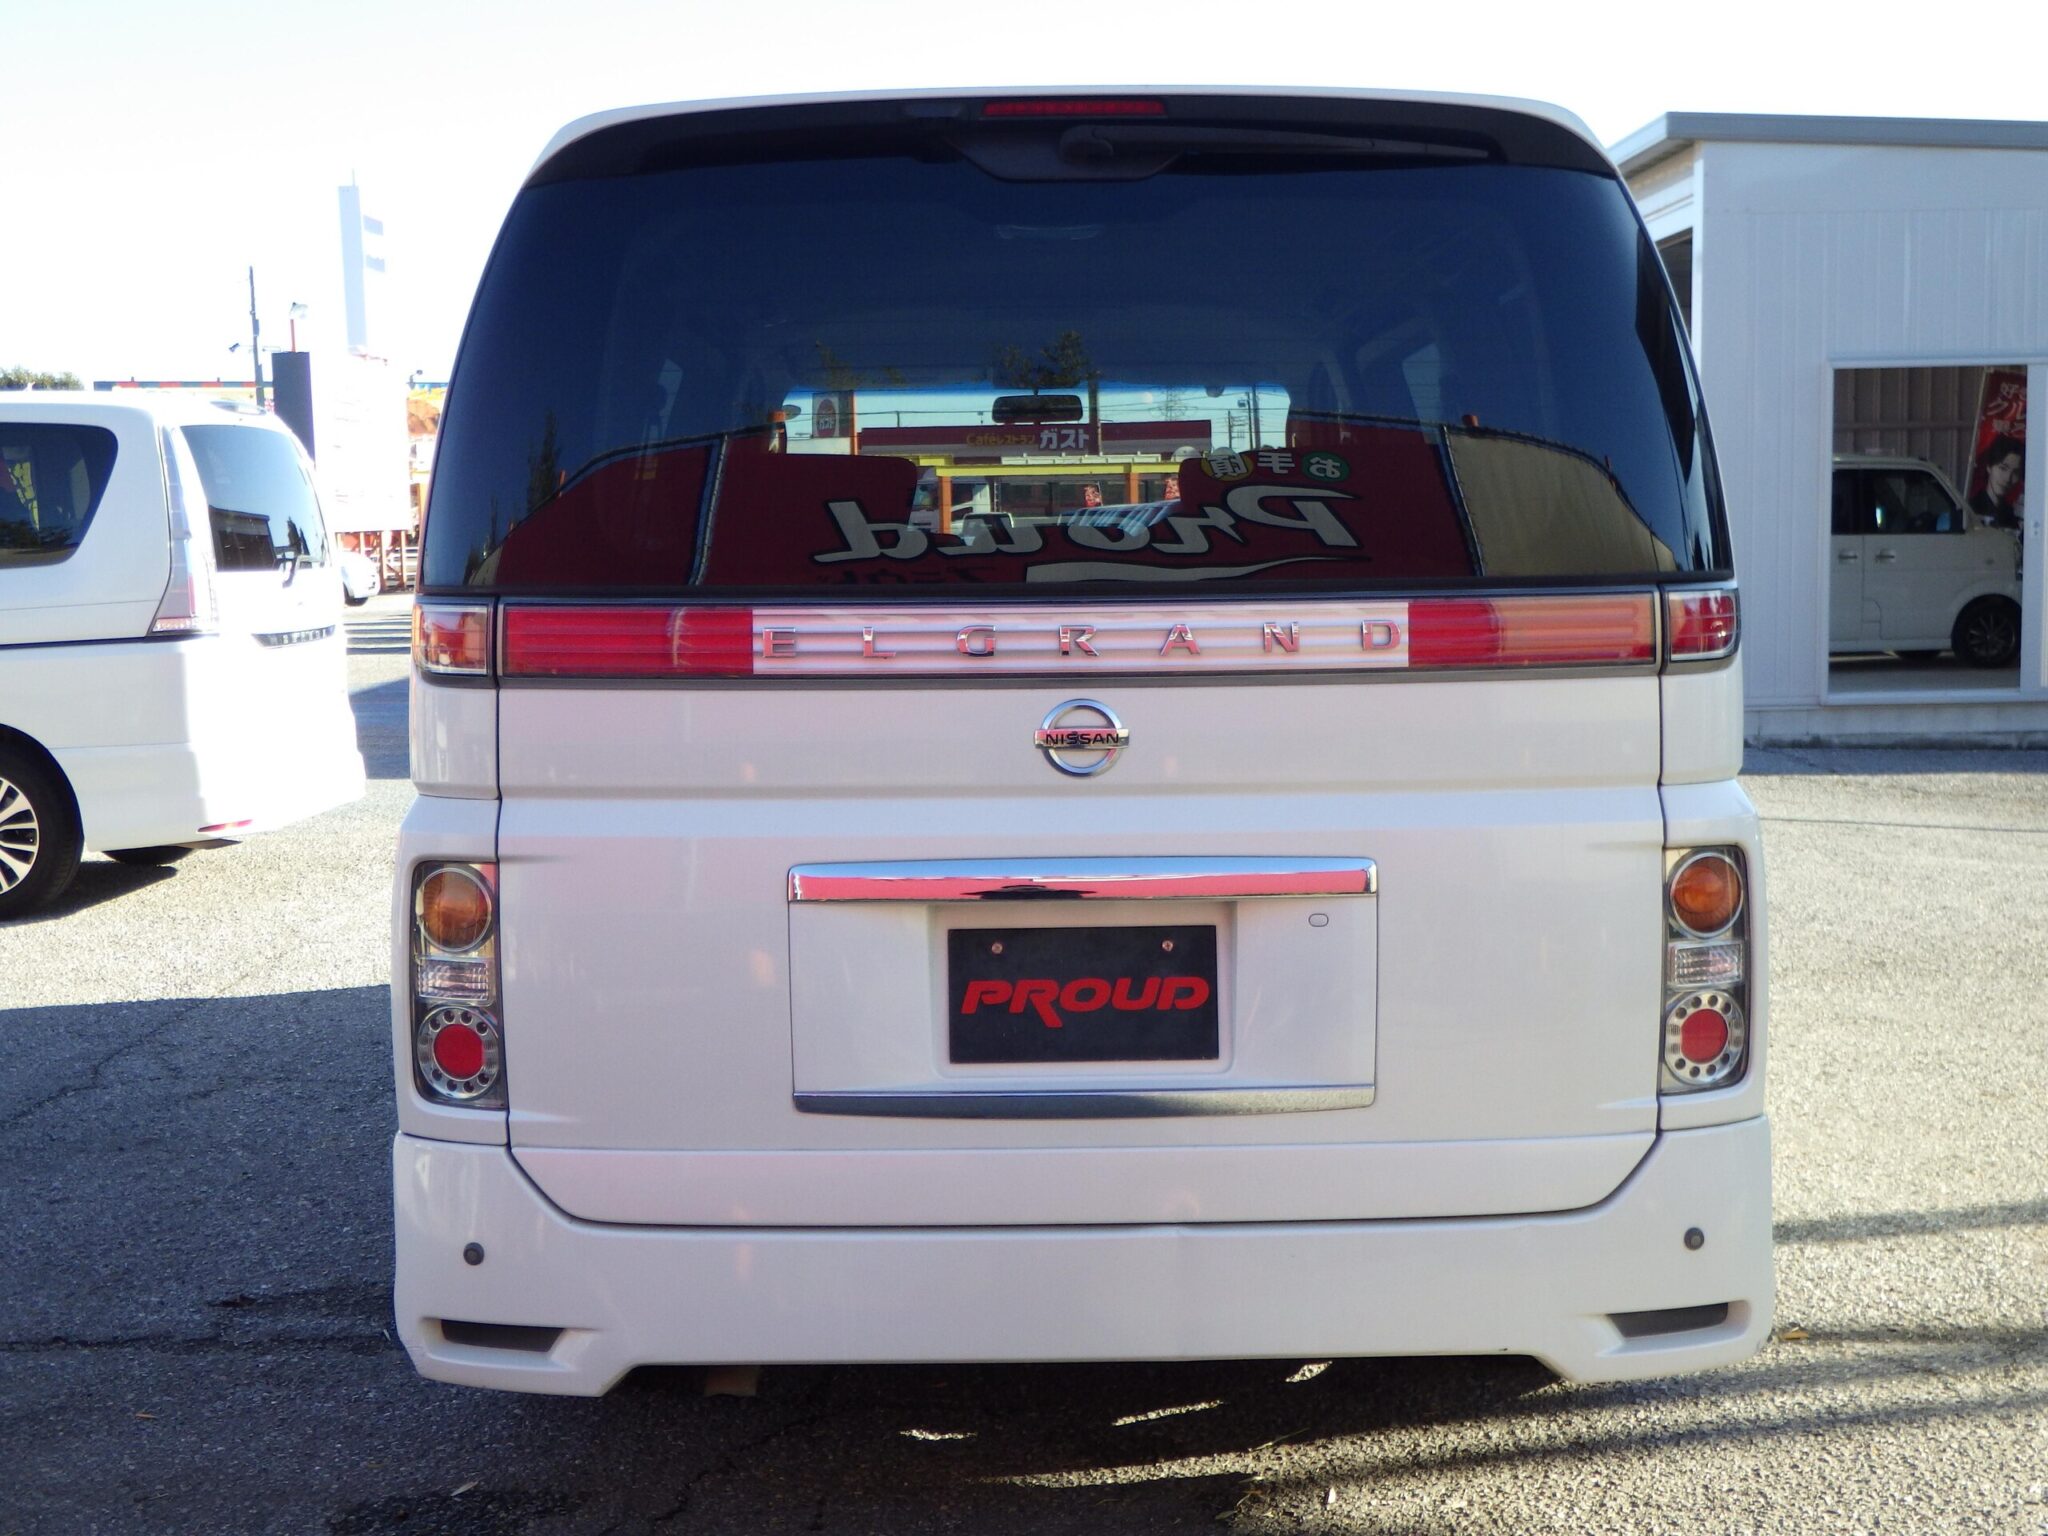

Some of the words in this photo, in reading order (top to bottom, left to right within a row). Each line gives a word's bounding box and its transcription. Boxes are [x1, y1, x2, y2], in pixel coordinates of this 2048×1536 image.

[1040, 428, 1089, 449] ガスト
[761, 619, 1402, 659] ELGRAND
[1045, 732, 1121, 747] NISSAN
[960, 975, 1210, 1029] PROUD
